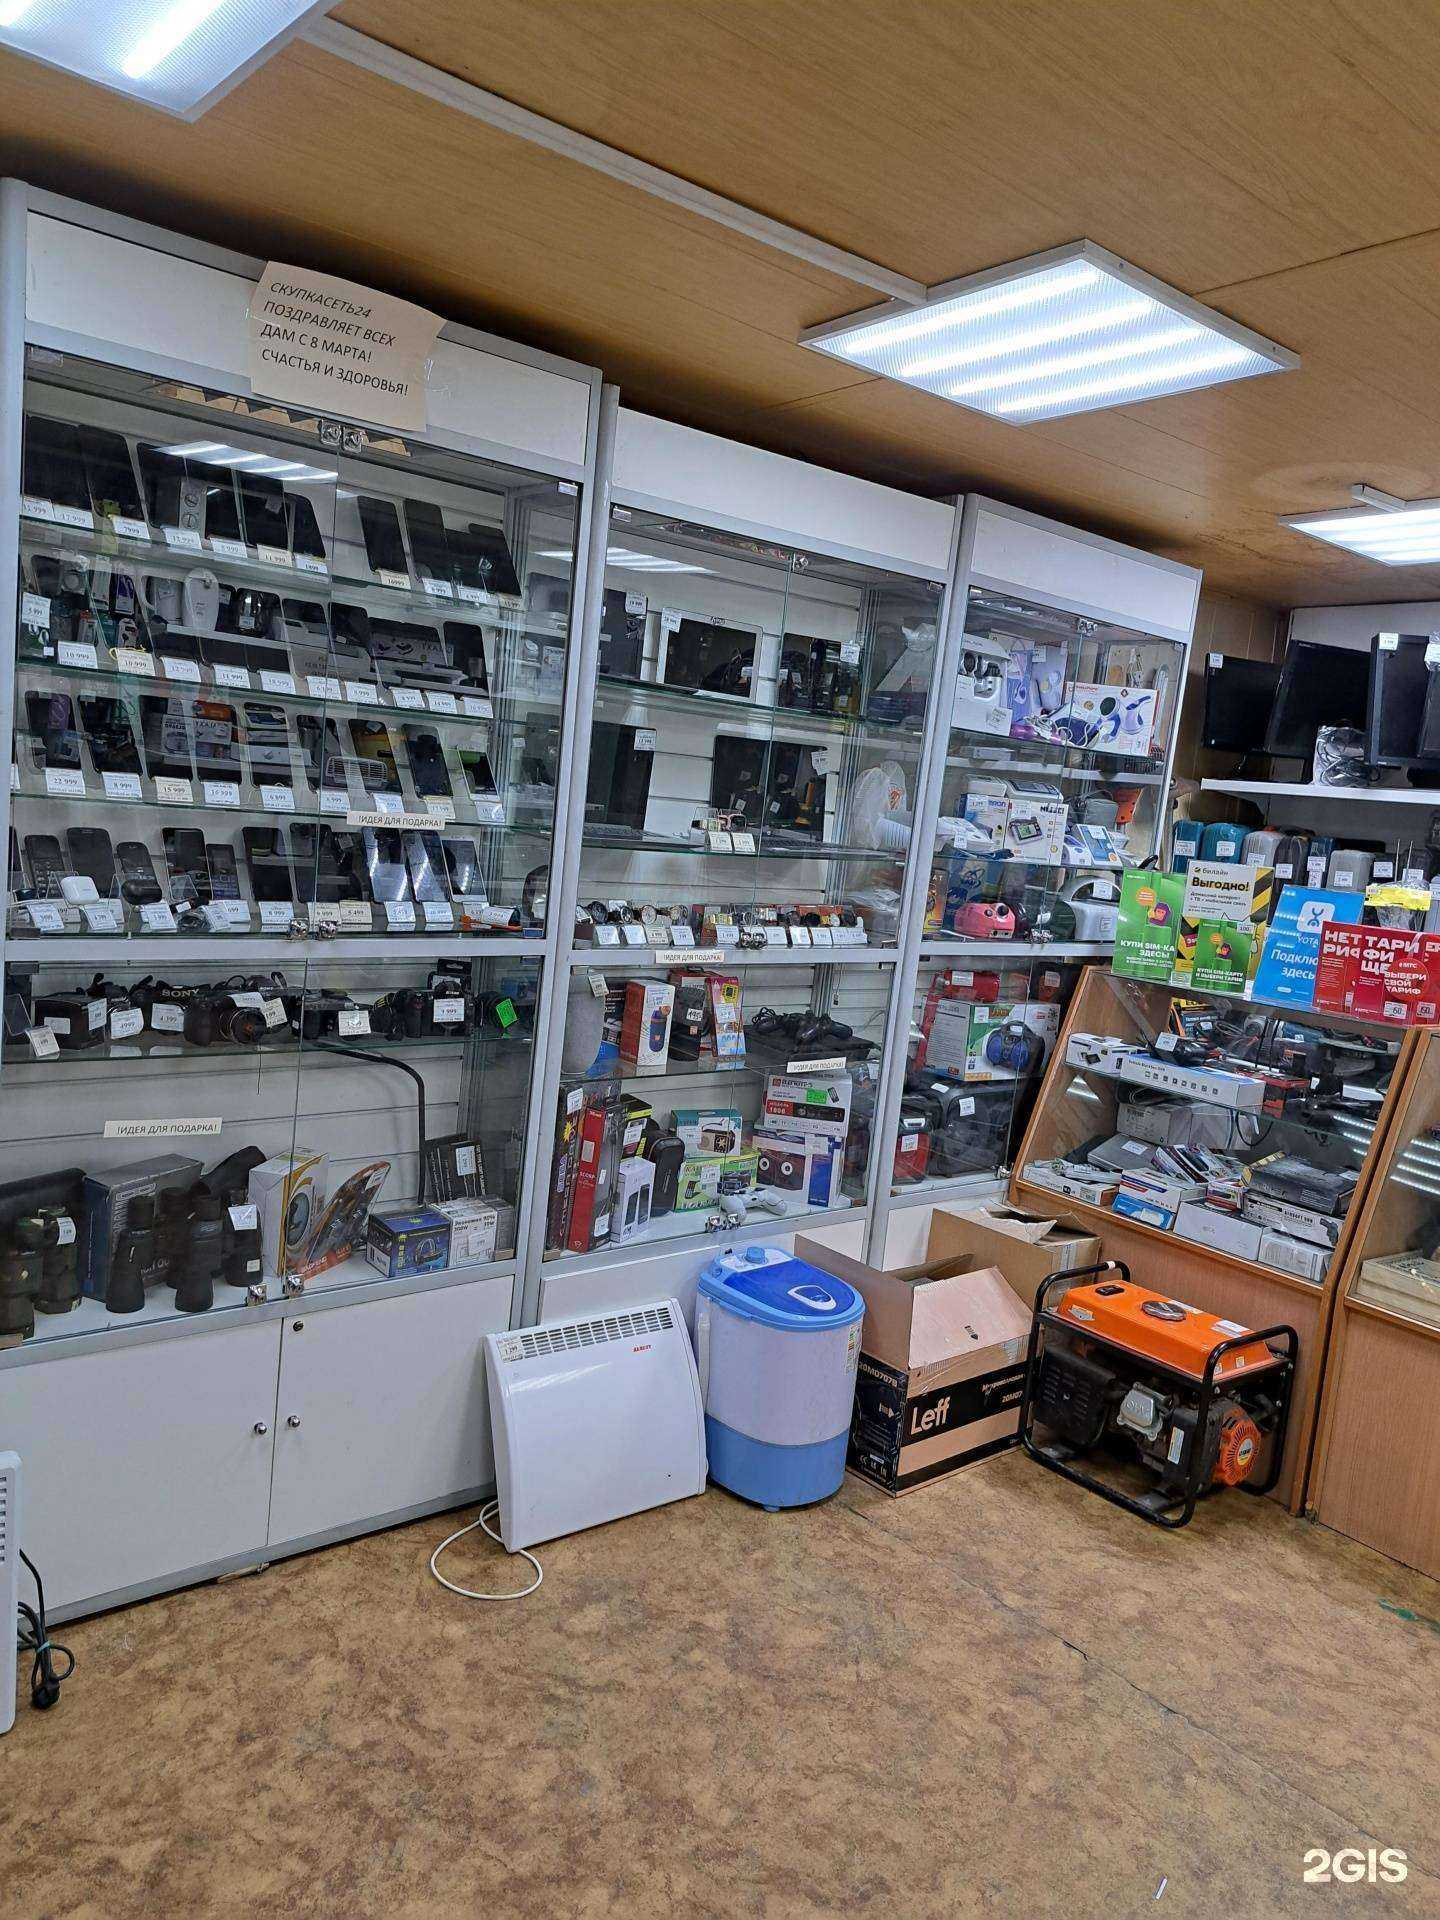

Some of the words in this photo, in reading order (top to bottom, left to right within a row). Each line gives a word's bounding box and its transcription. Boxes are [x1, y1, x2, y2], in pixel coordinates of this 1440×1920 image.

[270, 282, 373, 319] СКУПКАСЕТЬ24
[263, 300, 362, 337] ПОЗДРАВЛЯЕТ
[363, 328, 397, 347] ВСЕХ
[260, 323, 296, 342] ДАМ
[298, 333, 309, 346] С
[310, 337, 319, 349] 8
[321, 339, 373, 363] МАРТА!
[261, 348, 321, 373] СЧАСТЬЯ
[323, 364, 334, 377] И
[336, 367, 410, 396] ЗДОРОВЬЯ!
[384, 816, 402, 827] ДЛЯ
[403, 817, 442, 828] ПОДАРКА!
[1192, 876, 1250, 892] Выгодно!
[1120, 939, 1144, 948] КУПИ
[1325, 930, 1362, 945] НЕТ
[1362, 935, 1420, 953] ТАРИ
[681, 954, 694, 962] ДЛЯ
[1270, 948, 1319, 966] Подклю
[1363, 948, 1395, 963] ФИ
[1281, 967, 1315, 980] здесь
[1361, 960, 1391, 975] ЩЕ
[1384, 971, 1427, 981] ВЫБЕРИ
[1384, 977, 1412, 987] СВОЙ
[162, 988, 200, 999] SONY
[1385, 985, 1421, 995] ТАРИФ
[148, 1123, 168, 1135] ДЛЯ
[170, 1122, 218, 1134] ПОДАРКА!
[910, 1397, 951, 1436] Leff
